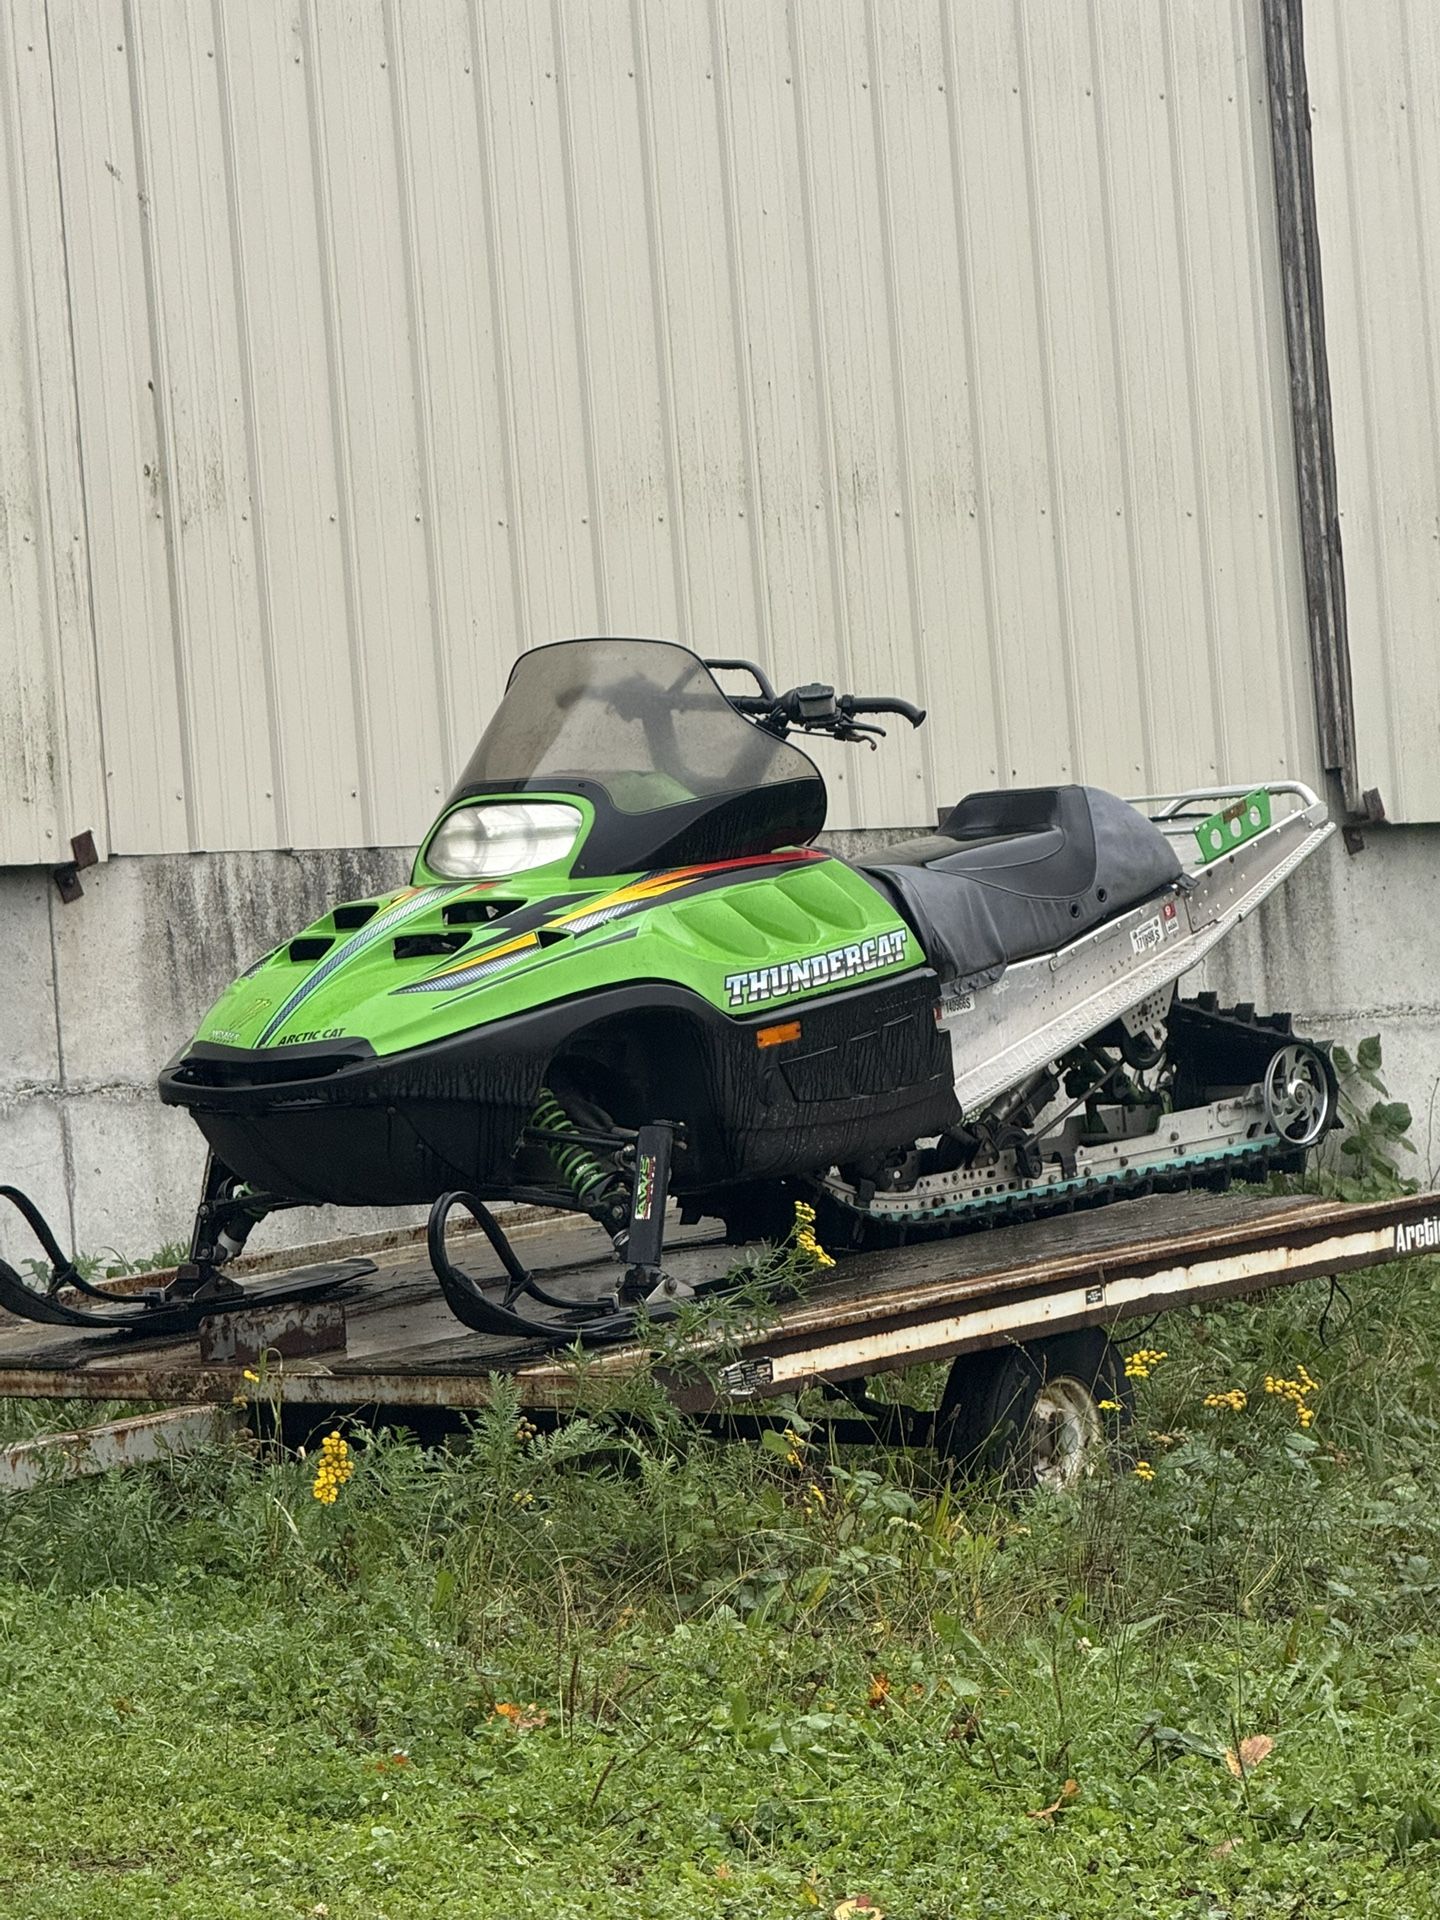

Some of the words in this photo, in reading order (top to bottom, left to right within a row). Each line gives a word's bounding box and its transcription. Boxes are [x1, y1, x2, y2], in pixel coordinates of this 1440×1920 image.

[725, 927, 907, 1007] THUNDERCAT
[278, 1030, 320, 1046] ARCTIC
[322, 1028, 346, 1038] CAT
[1396, 1216, 1440, 1253] Arcti
